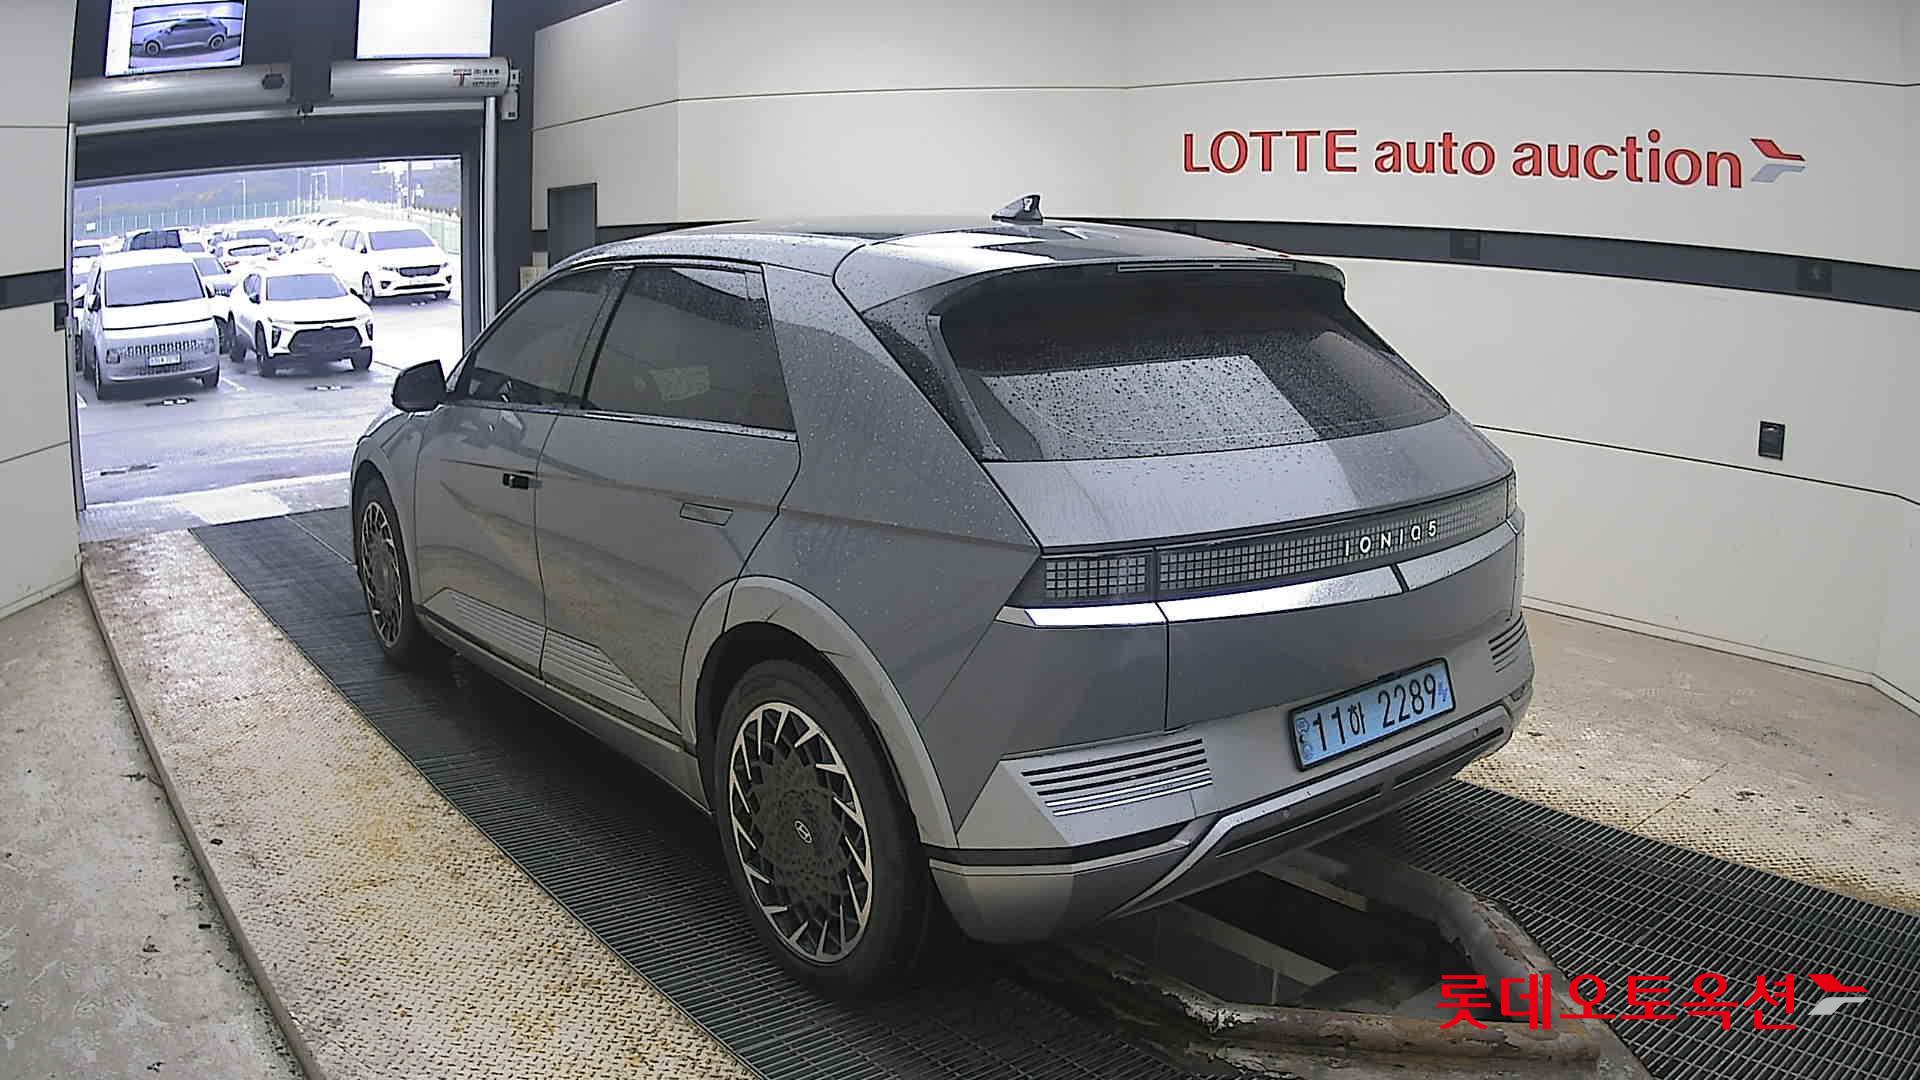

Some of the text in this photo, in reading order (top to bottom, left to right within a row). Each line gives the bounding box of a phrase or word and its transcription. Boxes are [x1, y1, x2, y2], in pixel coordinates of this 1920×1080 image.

[1184, 128, 1743, 189] LOTTE auto auction
[1312, 673, 1437, 751] 11하 2289
